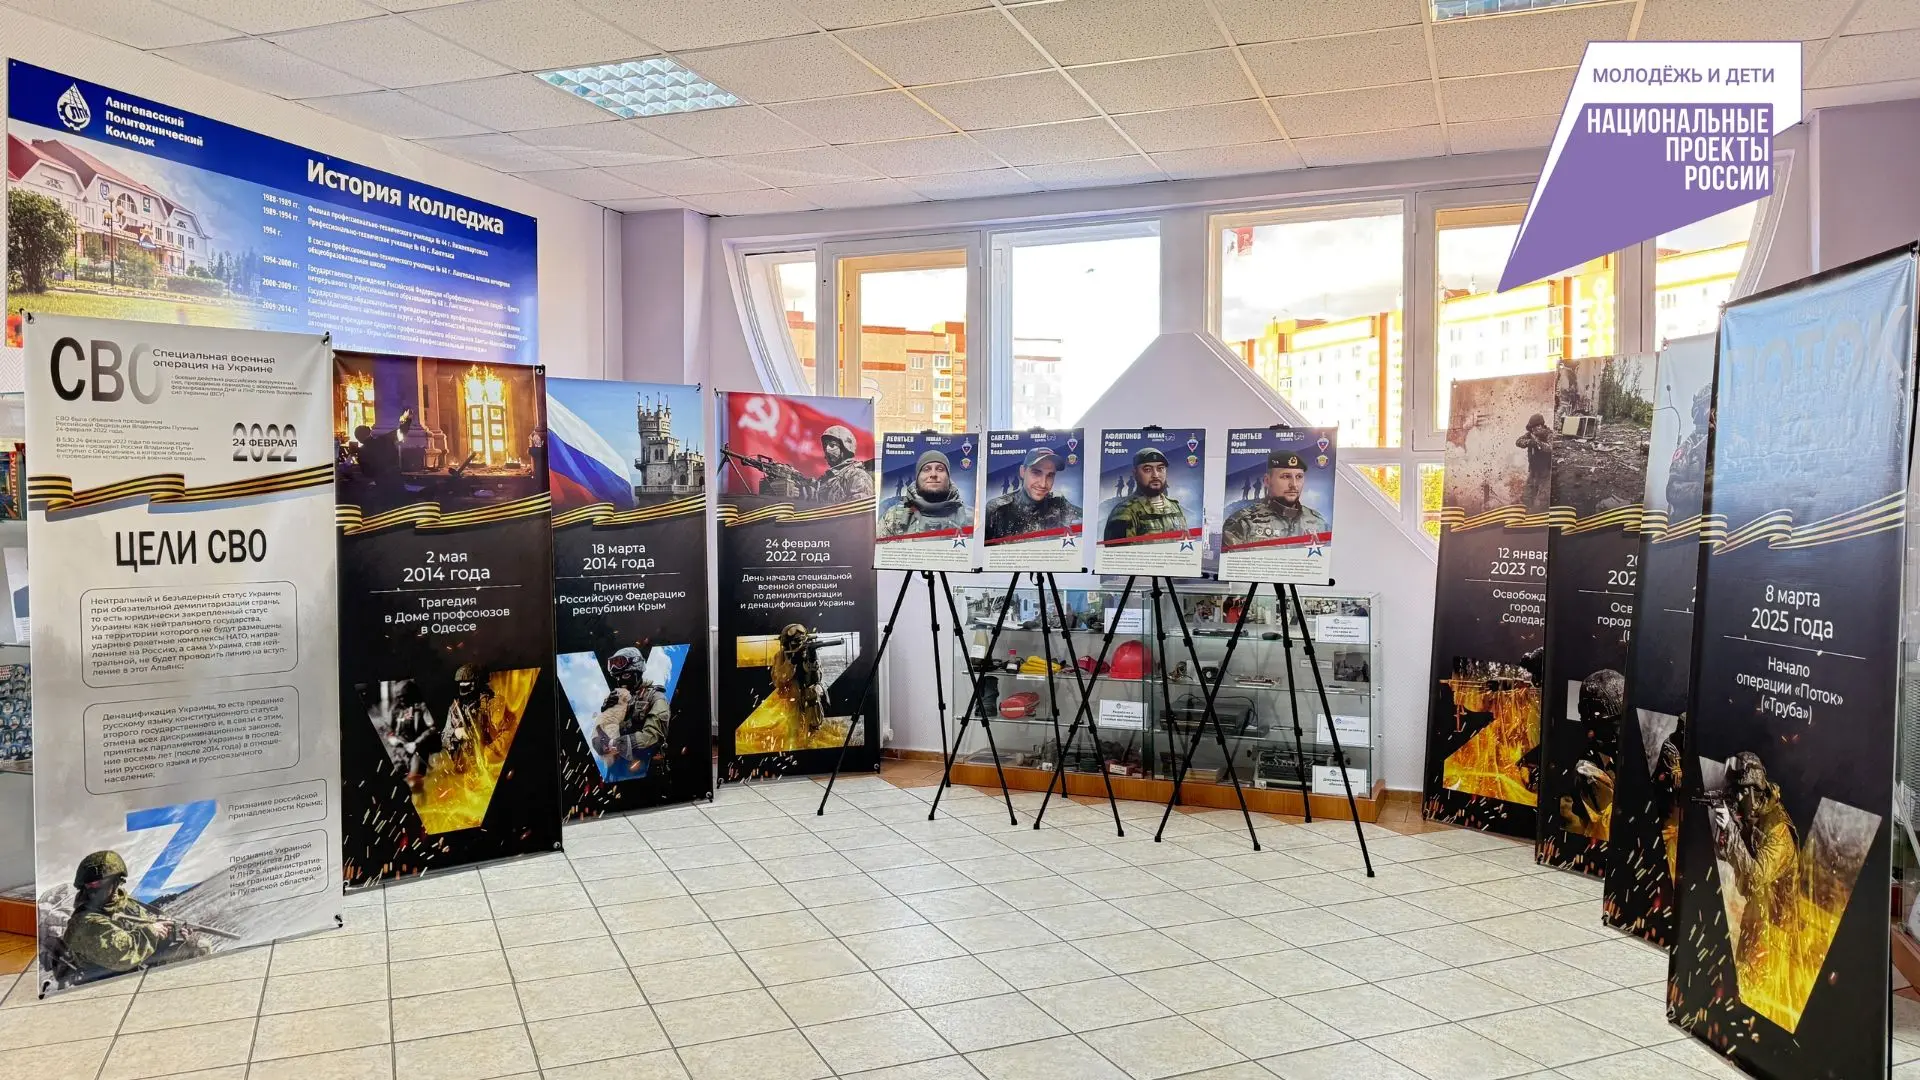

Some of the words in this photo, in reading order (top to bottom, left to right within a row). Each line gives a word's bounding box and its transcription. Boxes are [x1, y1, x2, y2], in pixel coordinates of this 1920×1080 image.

[106, 97, 184, 128] Лангепасский
[106, 111, 203, 146] Политехнический
[106, 126, 155, 147] Колледж
[308, 159, 401, 206] История
[408, 193, 504, 234] колледжа
[153, 349, 227, 361] Специальная
[231, 355, 275, 364] военная
[50, 336, 161, 404] СВО
[153, 359, 208, 370] операция
[227, 363, 273, 373] Украине
[232, 438, 245, 446] 24
[249, 438, 297, 447] ФЕВРАЛЯ
[116, 530, 197, 572] ЦЕЛИ
[208, 528, 267, 564] СВО
[592, 544, 605, 554] 18
[608, 544, 646, 556] марта
[765, 538, 779, 548] 24
[781, 538, 830, 550] февраля
[426, 551, 434, 563] 2
[439, 552, 468, 563] мая
[765, 551, 797, 562] 2022
[800, 552, 830, 563] года
[1498, 548, 1509, 558] 12
[1513, 550, 1548, 562] январ
[583, 557, 617, 570] 2014
[622, 558, 655, 570] года
[1491, 562, 1525, 575] 2023
[1531, 566, 1547, 578] го
[403, 567, 445, 582] 2014
[450, 568, 490, 581] года
[742, 574, 765, 582] День
[797, 573, 852, 582] специальной
[1608, 570, 1636, 585] 202
[594, 582, 645, 592] Принятие
[758, 582, 794, 590] военной
[796, 582, 838, 591] операции
[560, 594, 623, 604] Российскую
[625, 591, 686, 601] Федерацию
[766, 591, 842, 600] демилитаризации
[1493, 589, 1546, 602] Освобожд
[1765, 584, 1774, 602] 8
[1777, 589, 1820, 610] марта
[110, 604, 171, 612] обязательной
[173, 601, 250, 609] демилитаризации
[419, 597, 477, 609] Трагедия
[572, 604, 635, 616] республики
[638, 602, 666, 612] Крым
[748, 600, 817, 610] денацификации
[818, 600, 855, 608] Украины
[1611, 602, 1632, 613] Осв
[182, 609, 243, 617] закрепленный
[384, 615, 392, 623] в
[395, 612, 429, 624] Доме
[433, 608, 510, 621] профсоюзов
[421, 626, 428, 634] в
[431, 622, 477, 633] Одессе
[1751, 607, 1789, 632] 2025
[1794, 616, 1834, 641] года
[1768, 656, 1810, 678] Начало
[1736, 673, 1792, 695] операции
[1795, 683, 1844, 706] «Поток»
[1761, 695, 1813, 725] («Труба»)
[228, 799, 272, 810] Признание
[273, 792, 318, 803] российской
[228, 804, 294, 819] принадлежности
